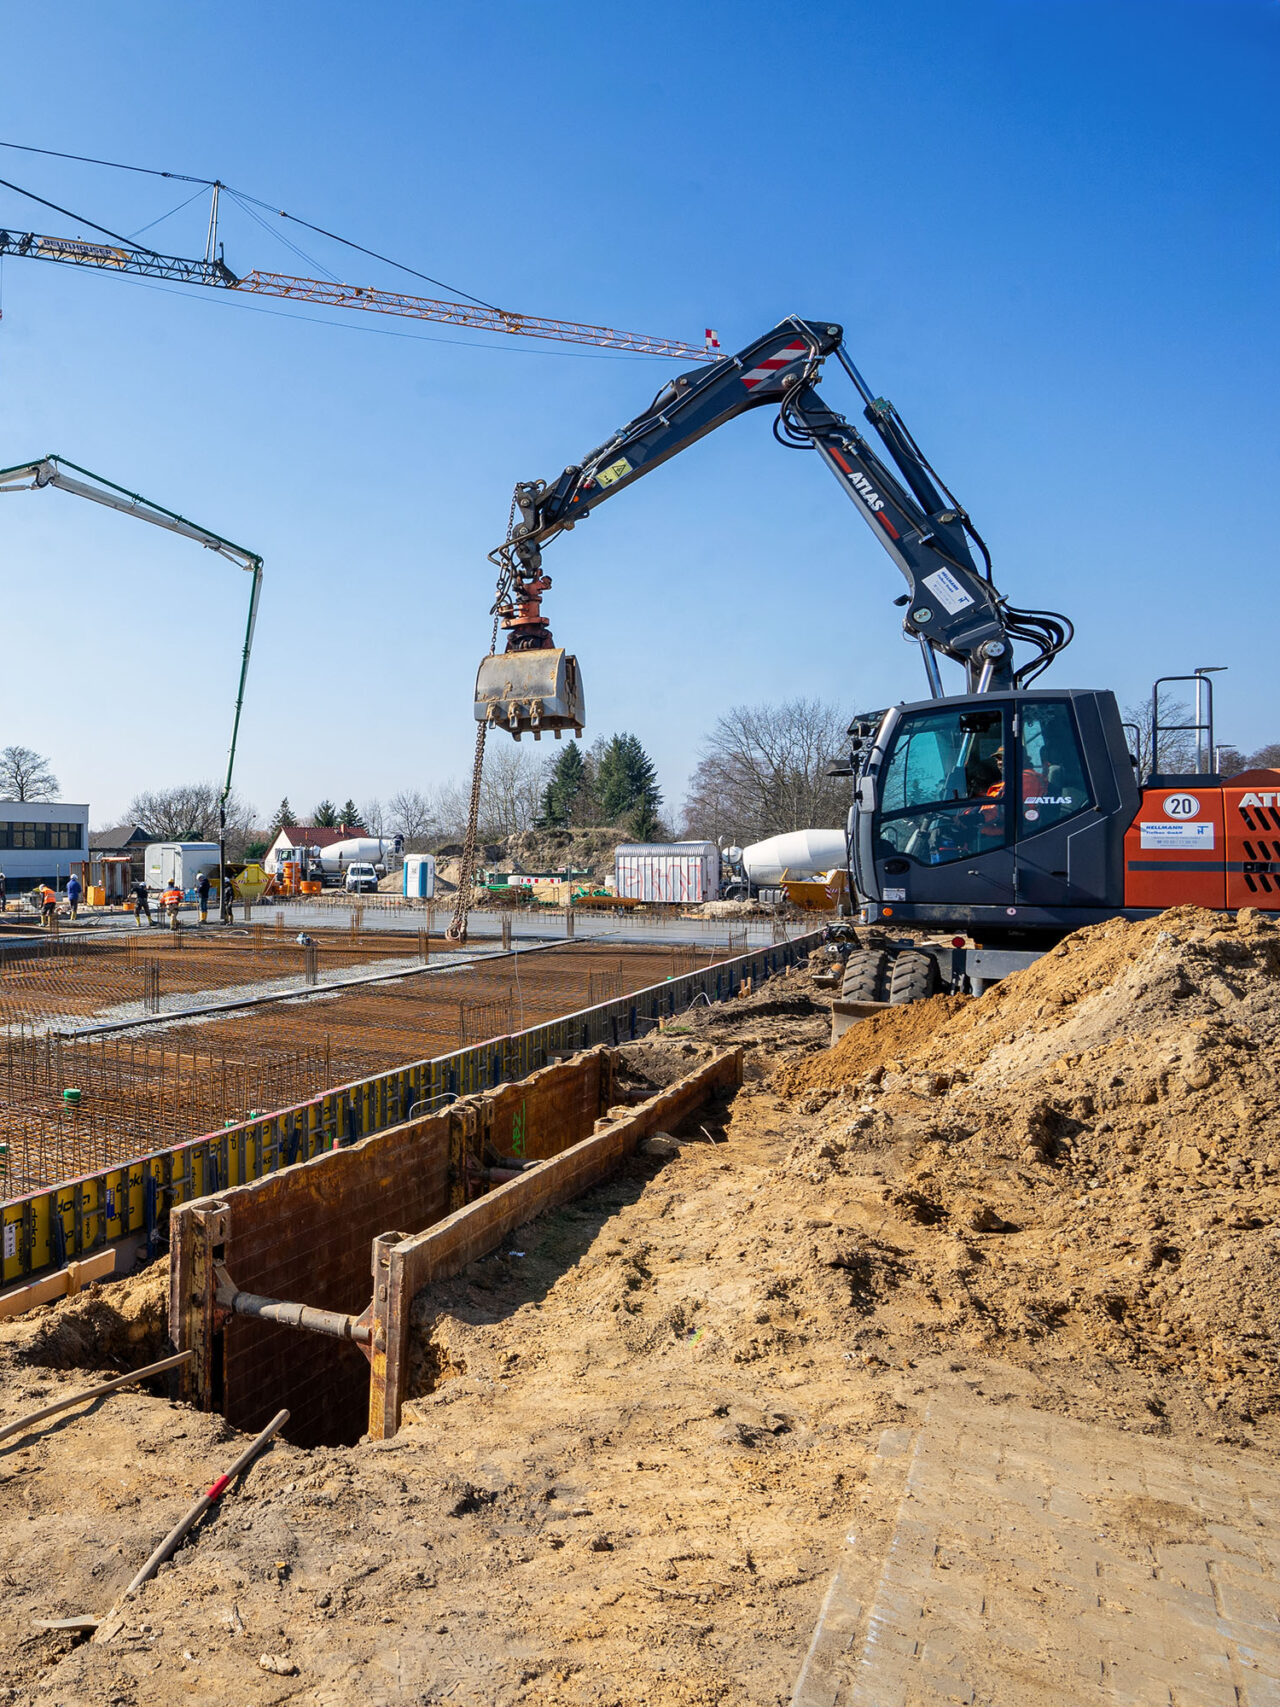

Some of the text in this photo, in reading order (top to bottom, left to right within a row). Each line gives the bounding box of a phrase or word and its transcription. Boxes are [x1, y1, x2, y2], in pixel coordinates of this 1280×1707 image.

[43, 239, 112, 256] BEUTLHAUSER
[847, 472, 884, 511] ATLAS
[1034, 796, 1072, 804] ATLAS
[1171, 798, 1192, 815] 20
[1238, 792, 1280, 808] AT
